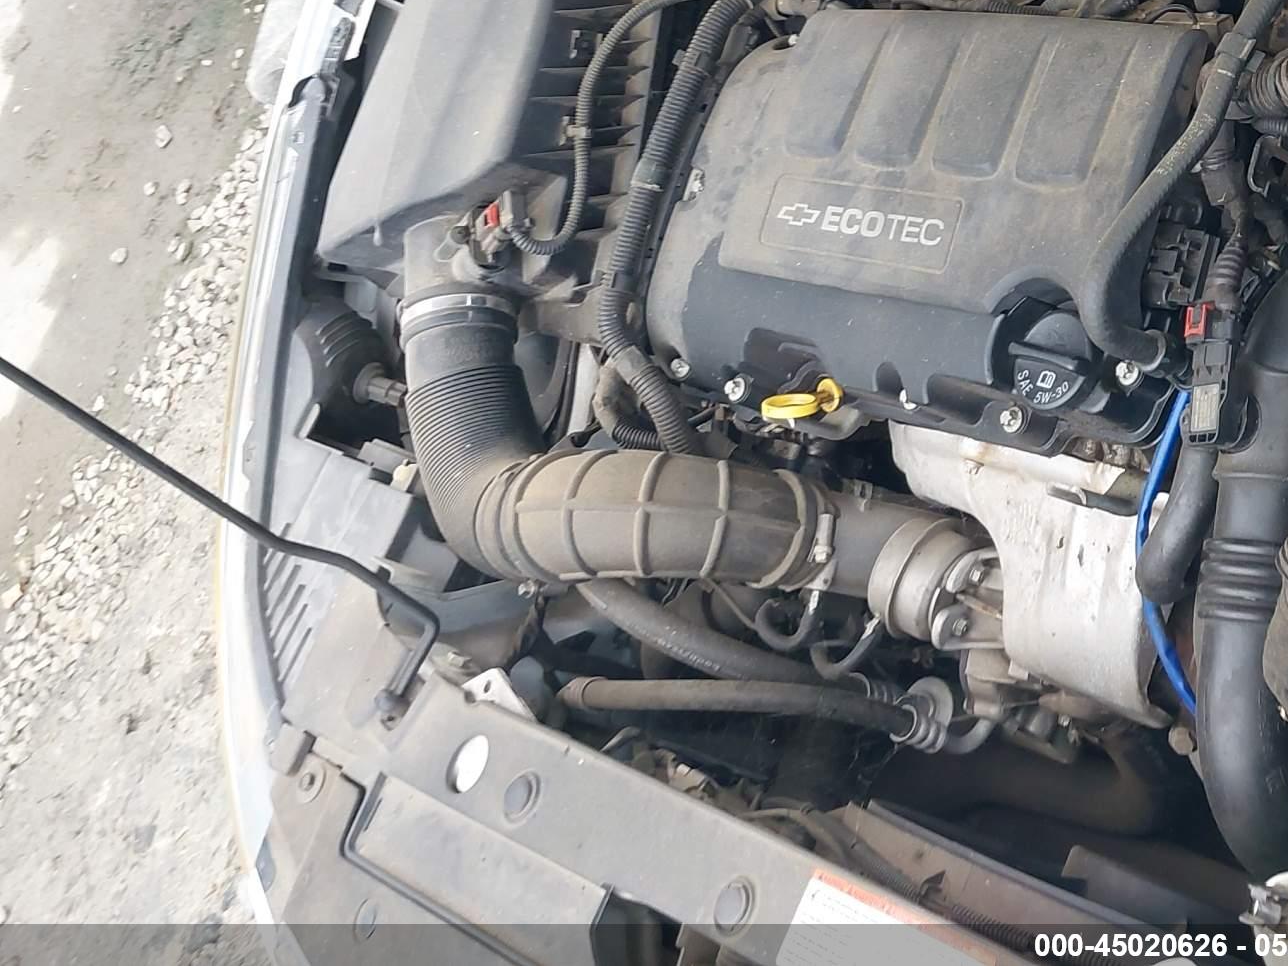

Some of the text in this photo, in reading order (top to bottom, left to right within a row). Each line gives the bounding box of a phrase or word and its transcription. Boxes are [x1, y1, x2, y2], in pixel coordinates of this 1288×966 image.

[820, 205, 945, 246] ECOTEC
[1017, 369, 1069, 403] SAE 5W-30
